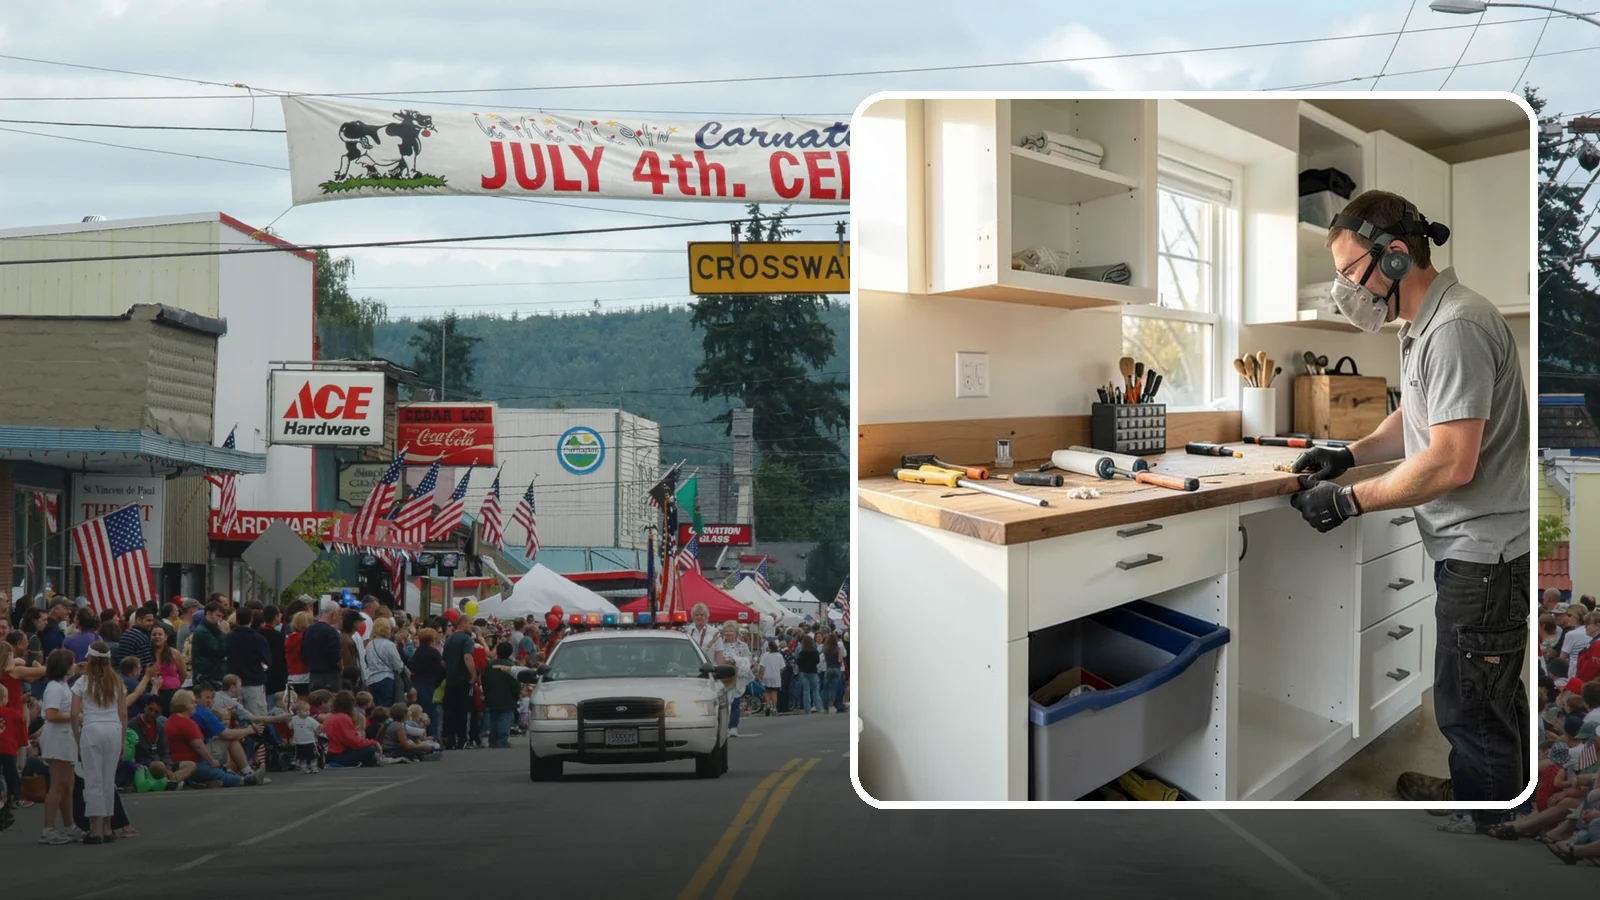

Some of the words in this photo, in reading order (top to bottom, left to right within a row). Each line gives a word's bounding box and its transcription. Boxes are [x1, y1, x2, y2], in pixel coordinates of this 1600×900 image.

[481, 141, 604, 193] JULY
[632, 150, 746, 198] 4th.
[697, 254, 850, 280] CROSSWA
[282, 380, 374, 420] ACE
[405, 409, 452, 422] CEDAR
[460, 409, 485, 421] LOG
[283, 421, 371, 437] Hardware
[353, 467, 386, 480] Simpl
[82, 484, 94, 495] St.
[95, 484, 124, 495] Vincent
[126, 486, 136, 495] de
[137, 485, 155, 495] Paul
[81, 503, 154, 522] THT
[212, 516, 331, 535] HARDARE
[688, 526, 741, 535] CRNATION
[699, 535, 730, 543] GLASS
